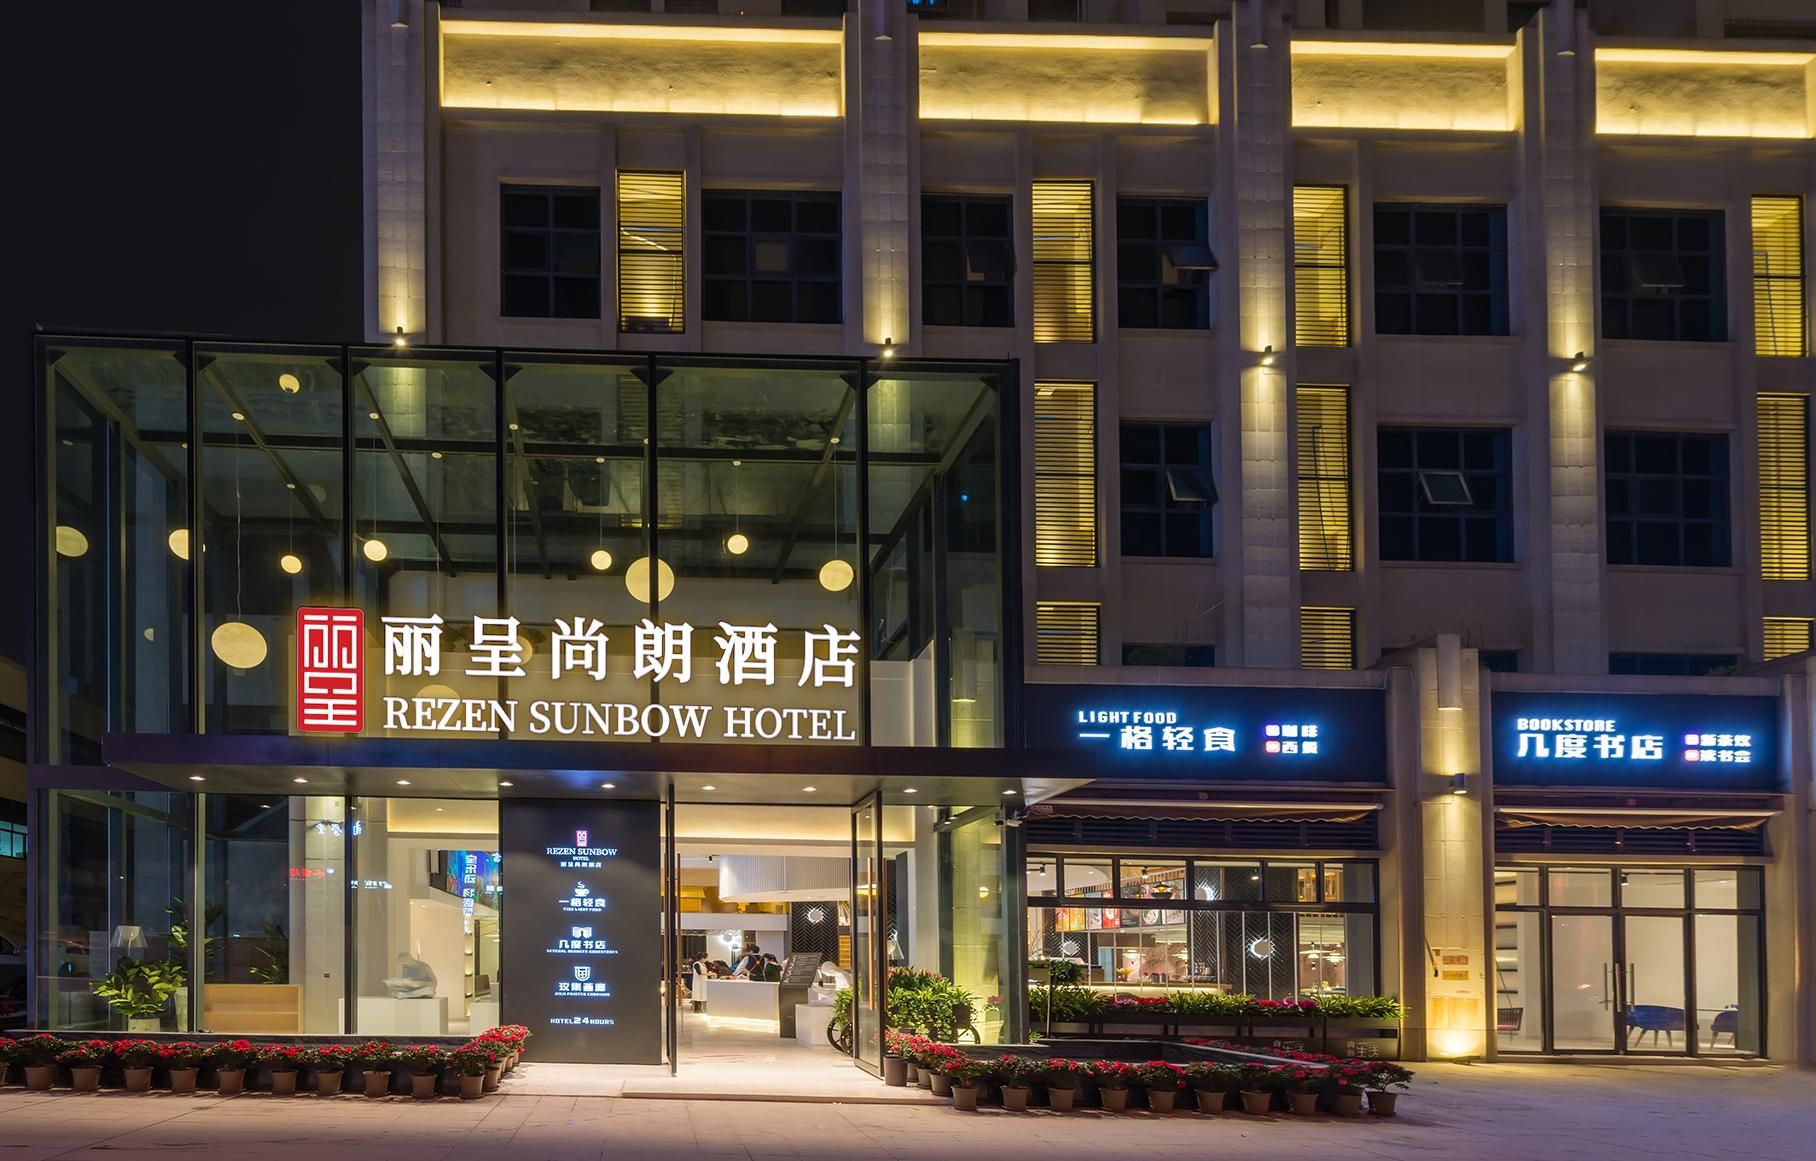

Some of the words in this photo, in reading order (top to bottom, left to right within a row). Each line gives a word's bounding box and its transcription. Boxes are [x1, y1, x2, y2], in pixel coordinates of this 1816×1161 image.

[381, 613, 861, 688] 丽呈尚朗酒店
[383, 697, 518, 733] REZEN
[529, 701, 712, 738] SUNBOW
[723, 706, 856, 741] HOTEL
[1078, 711, 1130, 723] LIGHT
[1133, 712, 1177, 724] FOOD
[1517, 718, 1616, 732] BOOKSTORE
[1079, 725, 1236, 752] 一格轻食
[1517, 733, 1663, 759] 几度书店
[546, 847, 576, 855] REZEN
[577, 848, 618, 856] SUNBOW
[559, 940, 606, 949] 几度书店
